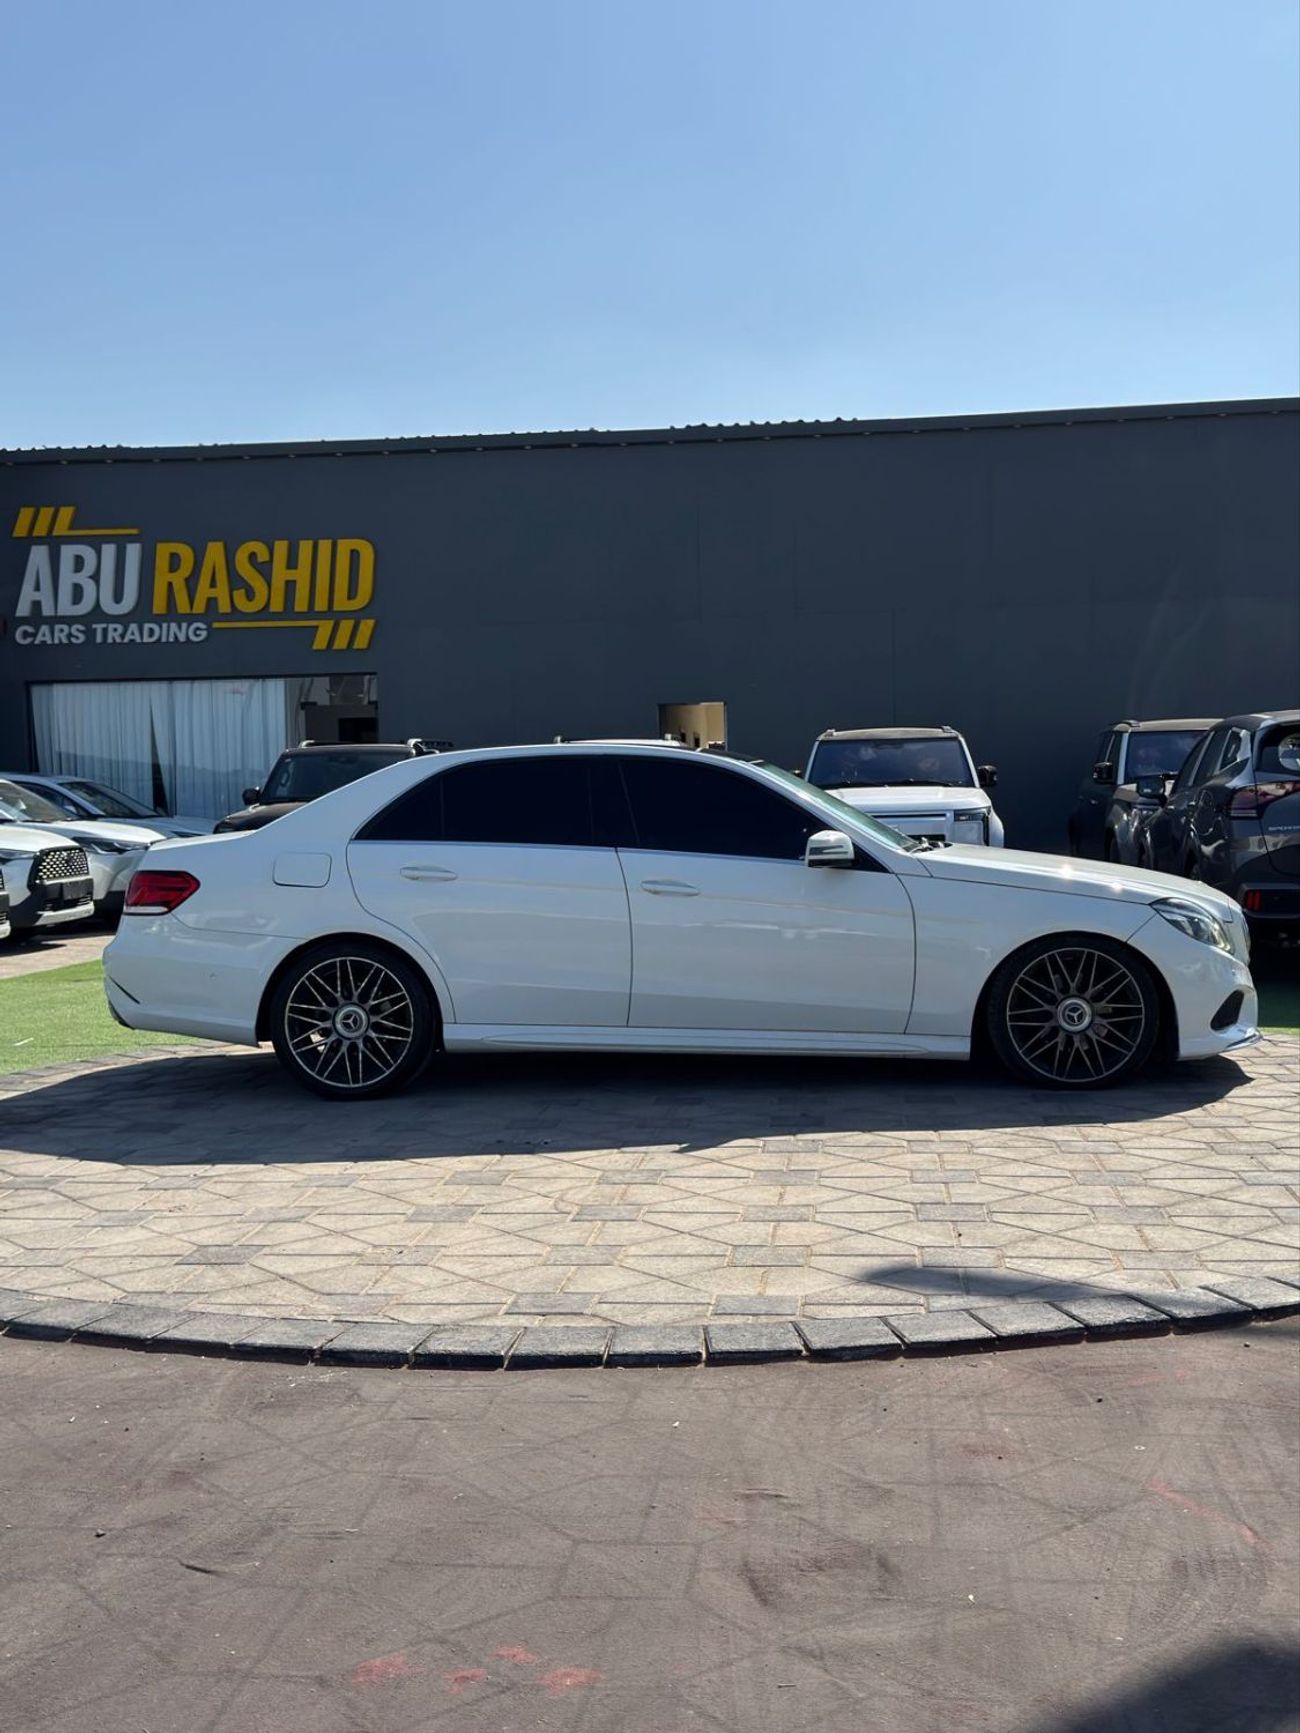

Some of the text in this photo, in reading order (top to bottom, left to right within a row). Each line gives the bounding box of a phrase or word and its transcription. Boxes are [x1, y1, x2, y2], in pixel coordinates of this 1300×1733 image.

[15, 538, 375, 617] ABU RASHID
[15, 621, 208, 644] CARS TRADING
